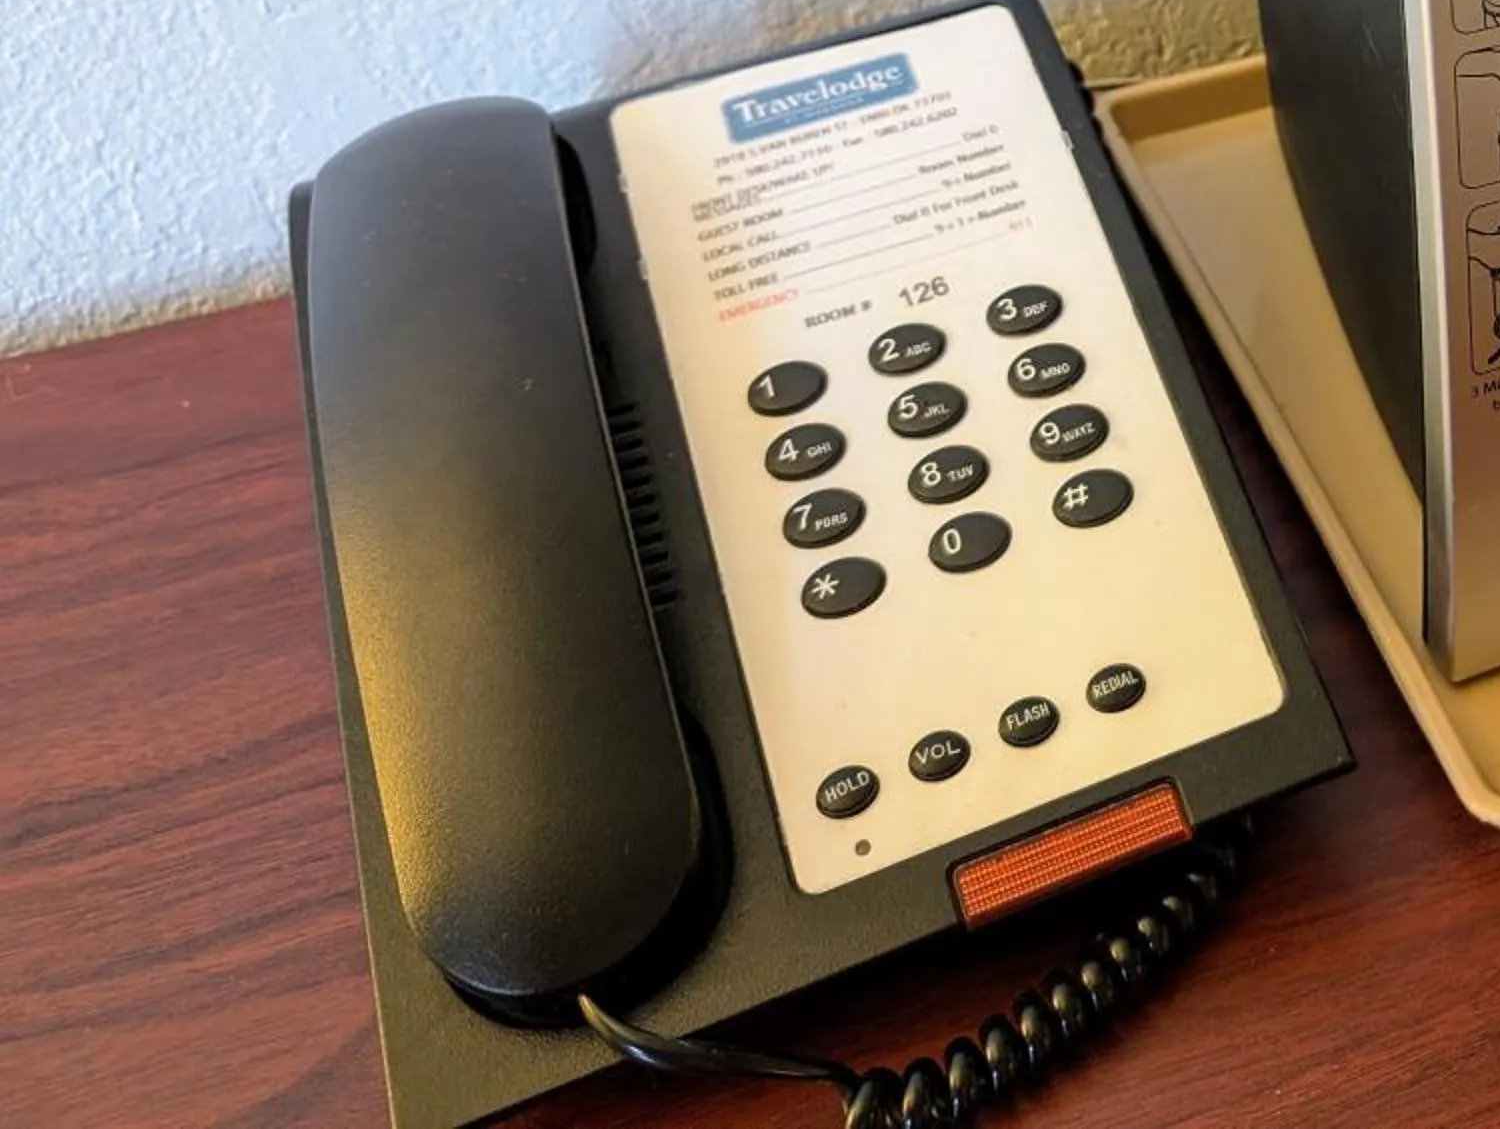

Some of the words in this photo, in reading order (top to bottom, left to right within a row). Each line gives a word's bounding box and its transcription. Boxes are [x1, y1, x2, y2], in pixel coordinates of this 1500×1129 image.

[731, 64, 904, 122] Travelodge
[742, 208, 785, 227] ROOM
[703, 242, 744, 262] LOCAL
[746, 230, 778, 248] CALL
[707, 260, 747, 282] LONG
[748, 240, 813, 269] DISTANCE
[713, 283, 747, 301] TOLL
[748, 272, 779, 291] FREE
[718, 287, 800, 323] EMERGENCY
[804, 303, 857, 328] ROOM
[898, 276, 950, 309] 126
[998, 298, 1018, 321] 3
[1023, 301, 1049, 318] DEF
[878, 337, 899, 362] 2
[905, 341, 933, 356] ABC
[1016, 358, 1036, 381] 6
[1041, 362, 1071, 379] MNO
[757, 376, 775, 399] 1
[1471, 386, 1479, 399] 3
[899, 394, 918, 419] 5
[924, 402, 951, 418] JKL
[1040, 421, 1060, 446] 9
[778, 437, 799, 461] 4
[807, 441, 833, 458] GHI
[920, 462, 941, 486] 8
[947, 465, 974, 482] TUV
[1062, 483, 1089, 510] #
[794, 503, 813, 529] 7
[943, 528, 962, 556] 0
[1091, 670, 1139, 699] REDIAL
[1006, 702, 1050, 732] FLASH
[915, 739, 961, 766] VOL
[824, 771, 871, 804] HOLD
